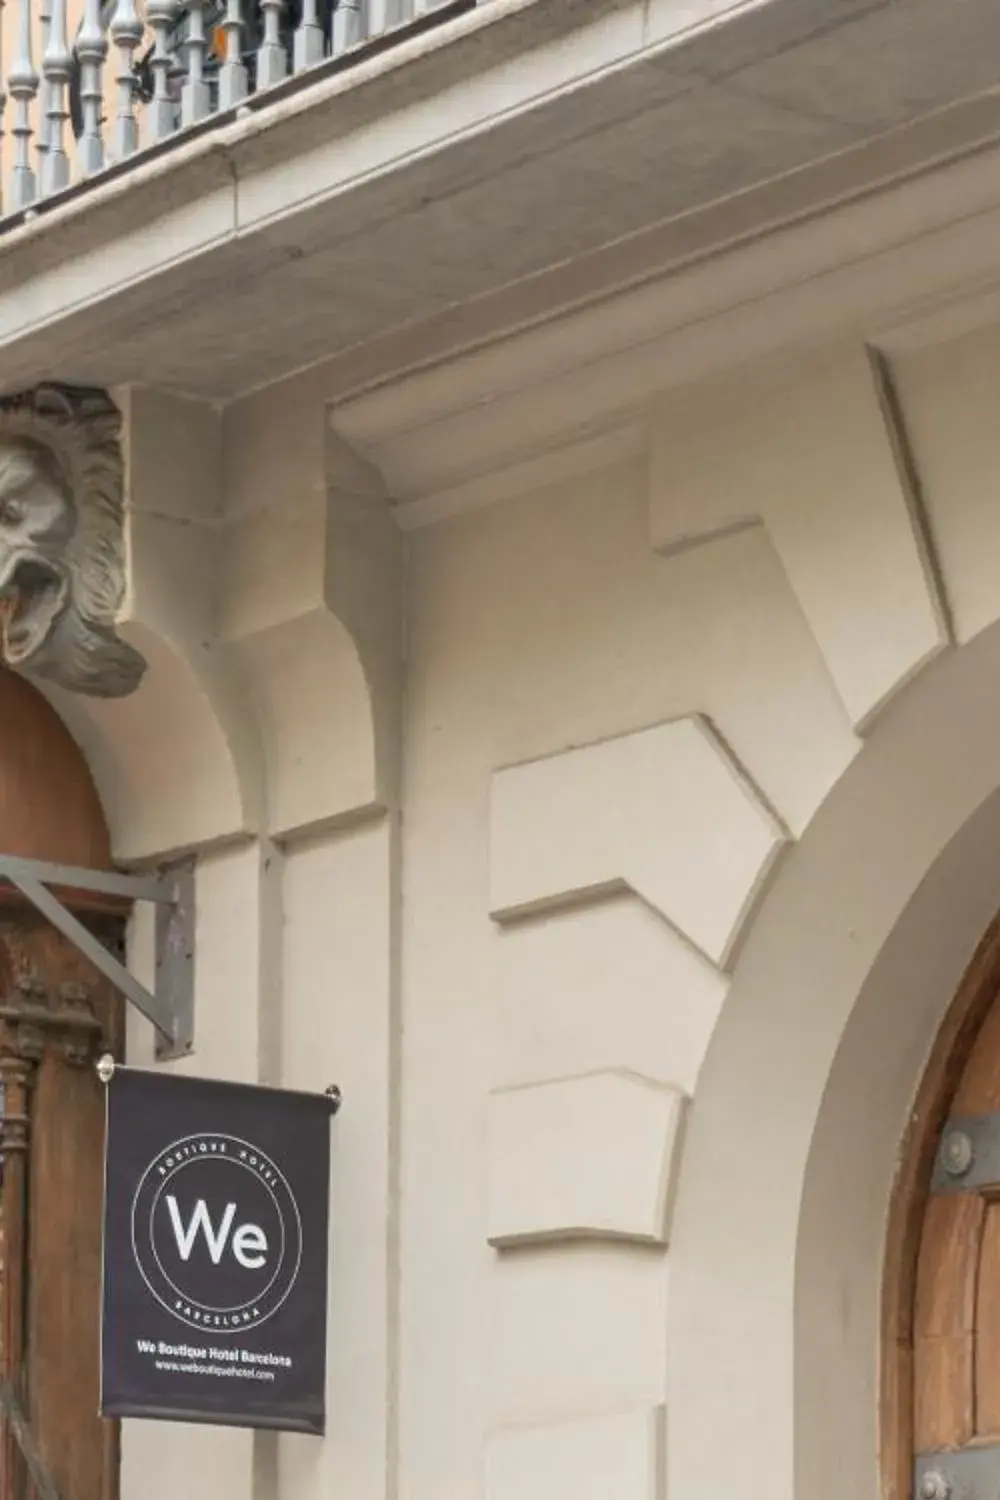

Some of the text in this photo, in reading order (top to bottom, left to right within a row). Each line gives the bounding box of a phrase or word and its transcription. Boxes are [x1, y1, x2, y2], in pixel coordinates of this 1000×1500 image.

[165, 1194, 269, 1270] We
[175, 1300, 260, 1326] BARCELONA
[136, 1340, 292, 1367] We Boutique Hotel Barcelona
